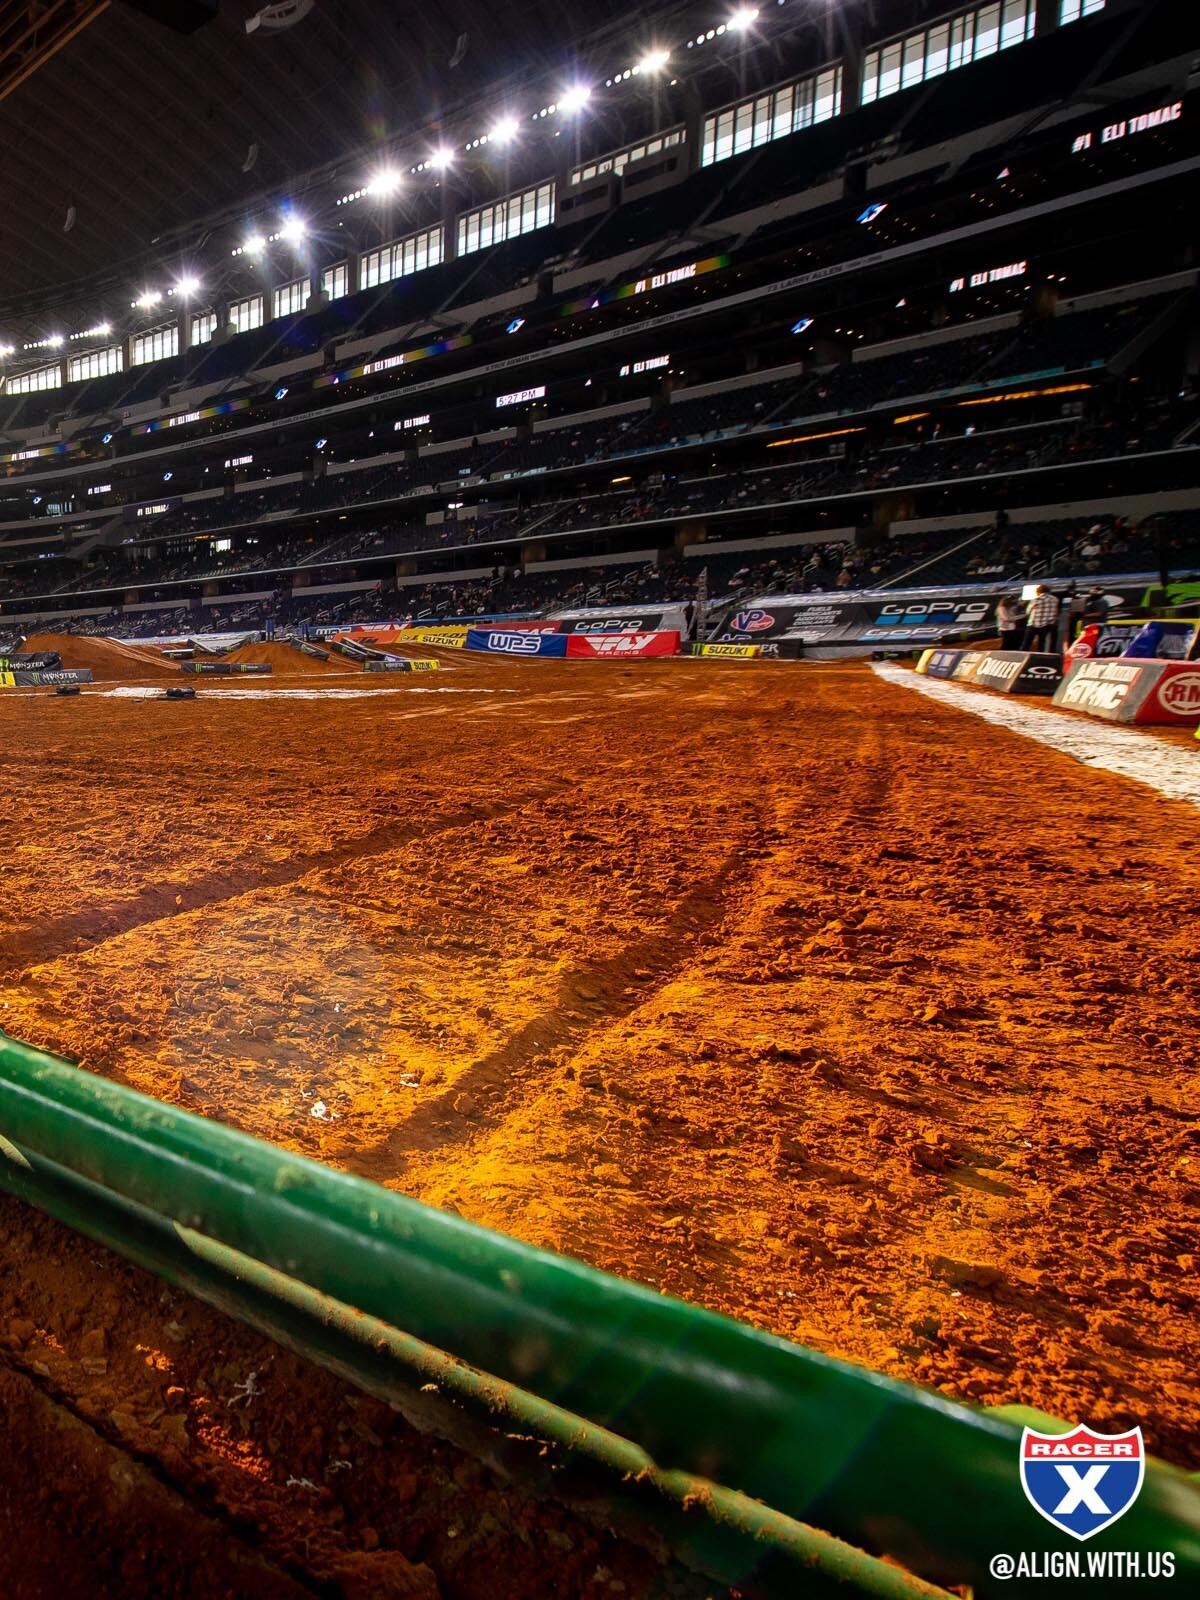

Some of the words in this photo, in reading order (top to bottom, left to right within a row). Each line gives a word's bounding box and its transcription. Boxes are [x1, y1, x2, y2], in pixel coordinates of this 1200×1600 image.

[1071, 132, 1092, 154] #1
[1101, 121, 1127, 144] ELI
[1128, 100, 1183, 135] TOMAC
[499, 394, 518, 406] 5:27
[522, 389, 536, 400] PM
[880, 602, 990, 615] GoPro
[575, 619, 643, 630] GoPro
[735, 610, 766, 631] VP
[422, 635, 459, 646] SUZUKI
[488, 633, 542, 653] WPS
[584, 634, 657, 651] FLY
[709, 645, 749, 655] SUZUKI
[414, 662, 432, 670] SUZUKI
